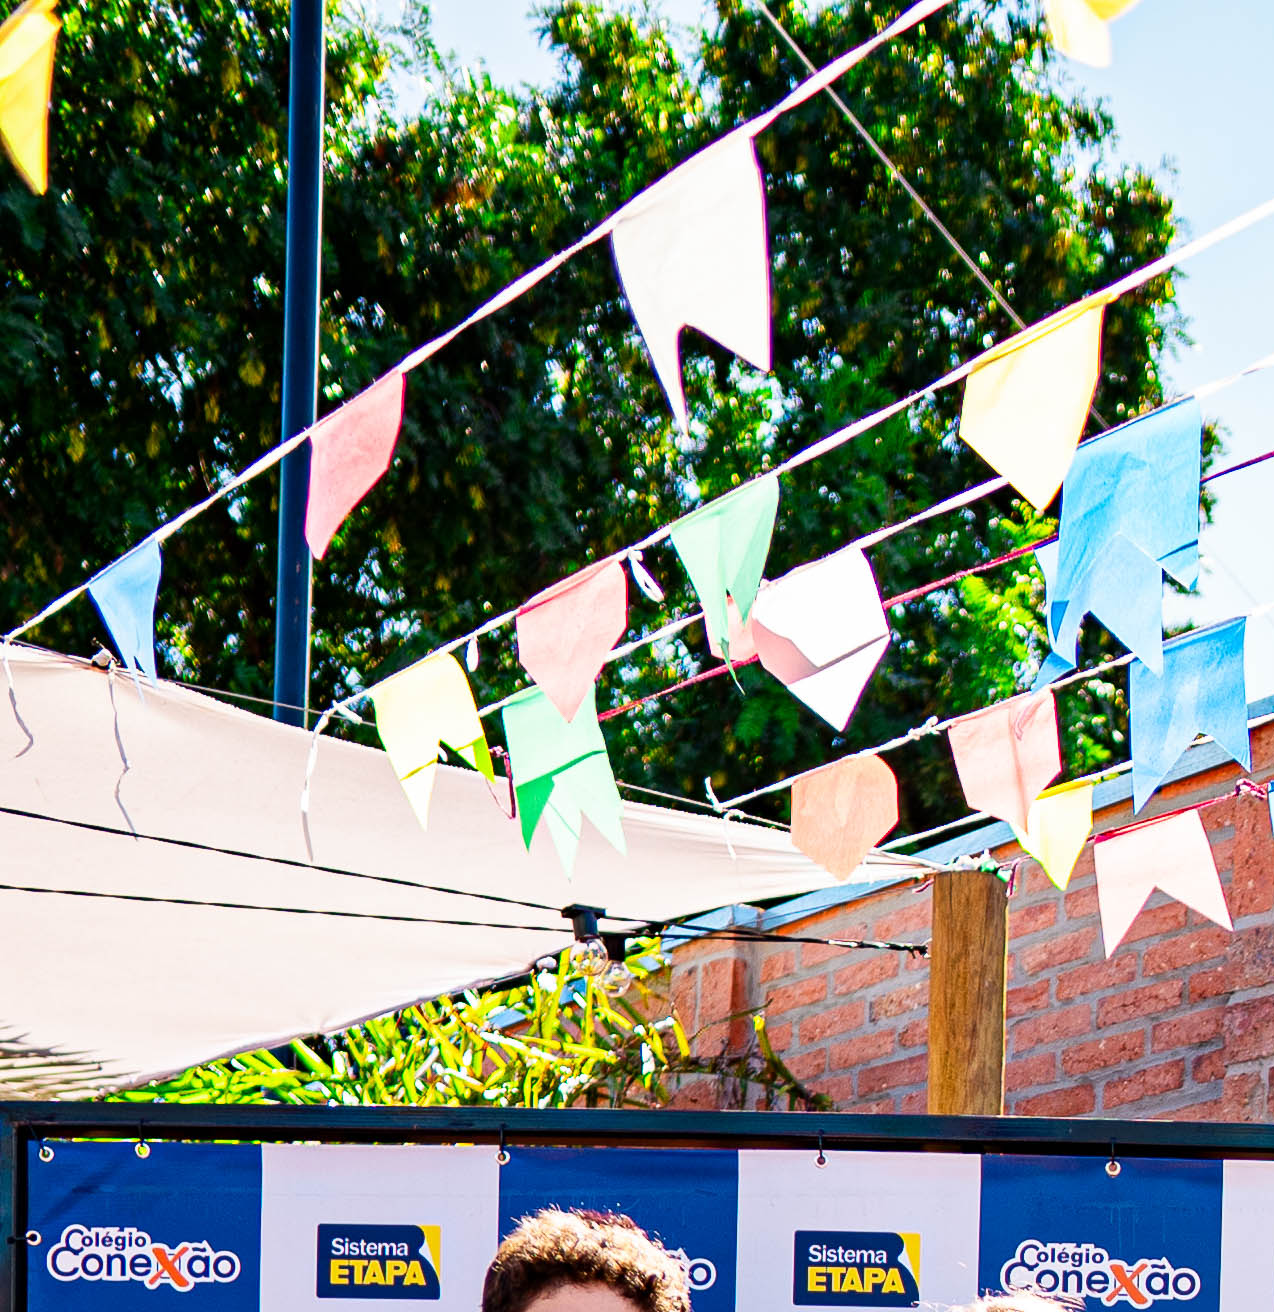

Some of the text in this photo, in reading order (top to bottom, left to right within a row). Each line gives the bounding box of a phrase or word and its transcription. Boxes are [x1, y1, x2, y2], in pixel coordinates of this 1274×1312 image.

[65, 1228, 146, 1252] Colégio
[331, 1238, 408, 1257] Sistema
[809, 1244, 887, 1263] Sistema
[1019, 1244, 1104, 1270] Colégio
[330, 1259, 426, 1286] ETAPA
[808, 1267, 905, 1293] ETAPA
